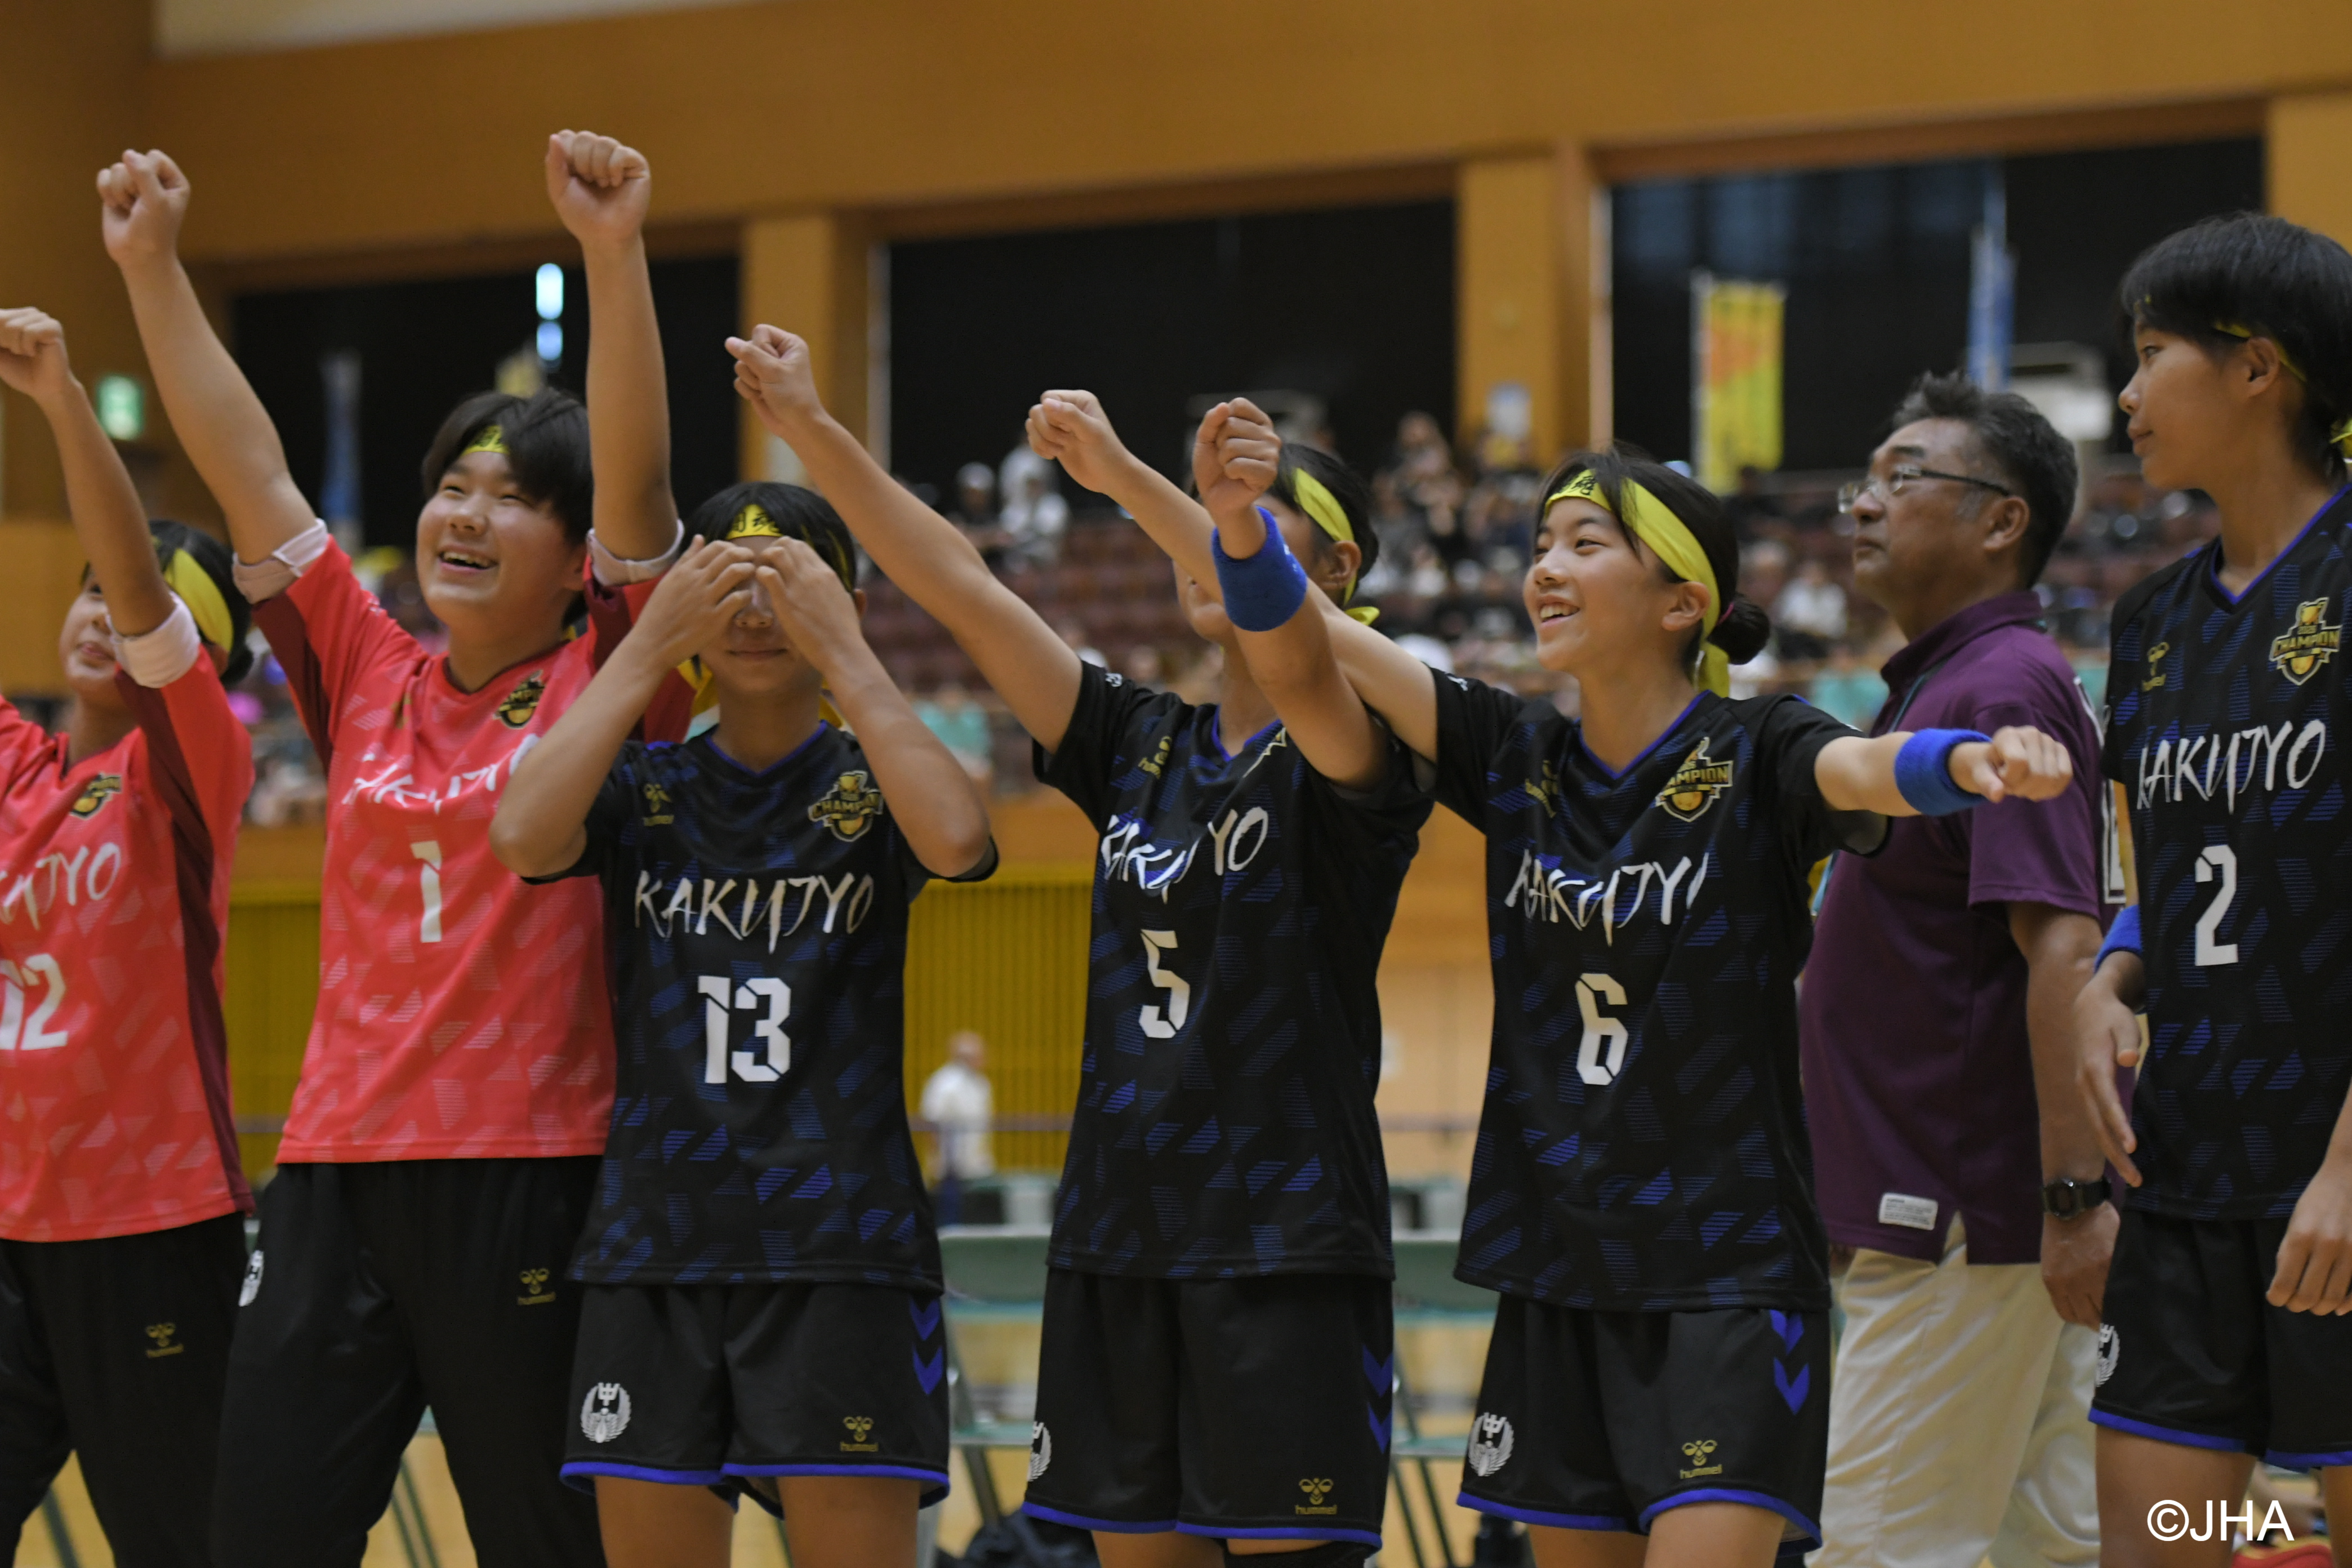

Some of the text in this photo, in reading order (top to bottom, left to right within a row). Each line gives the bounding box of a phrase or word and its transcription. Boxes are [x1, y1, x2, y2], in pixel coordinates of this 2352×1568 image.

[1664, 766, 1729, 789] AMPION
[411, 841, 442, 943] 1
[635, 870, 874, 955] KAKUJYO
[2195, 844, 2238, 966] 2
[0, 954, 69, 1050] 12
[698, 975, 791, 1084] 13
[1139, 929, 1190, 1039] 5
[1575, 973, 1629, 1086] 6
